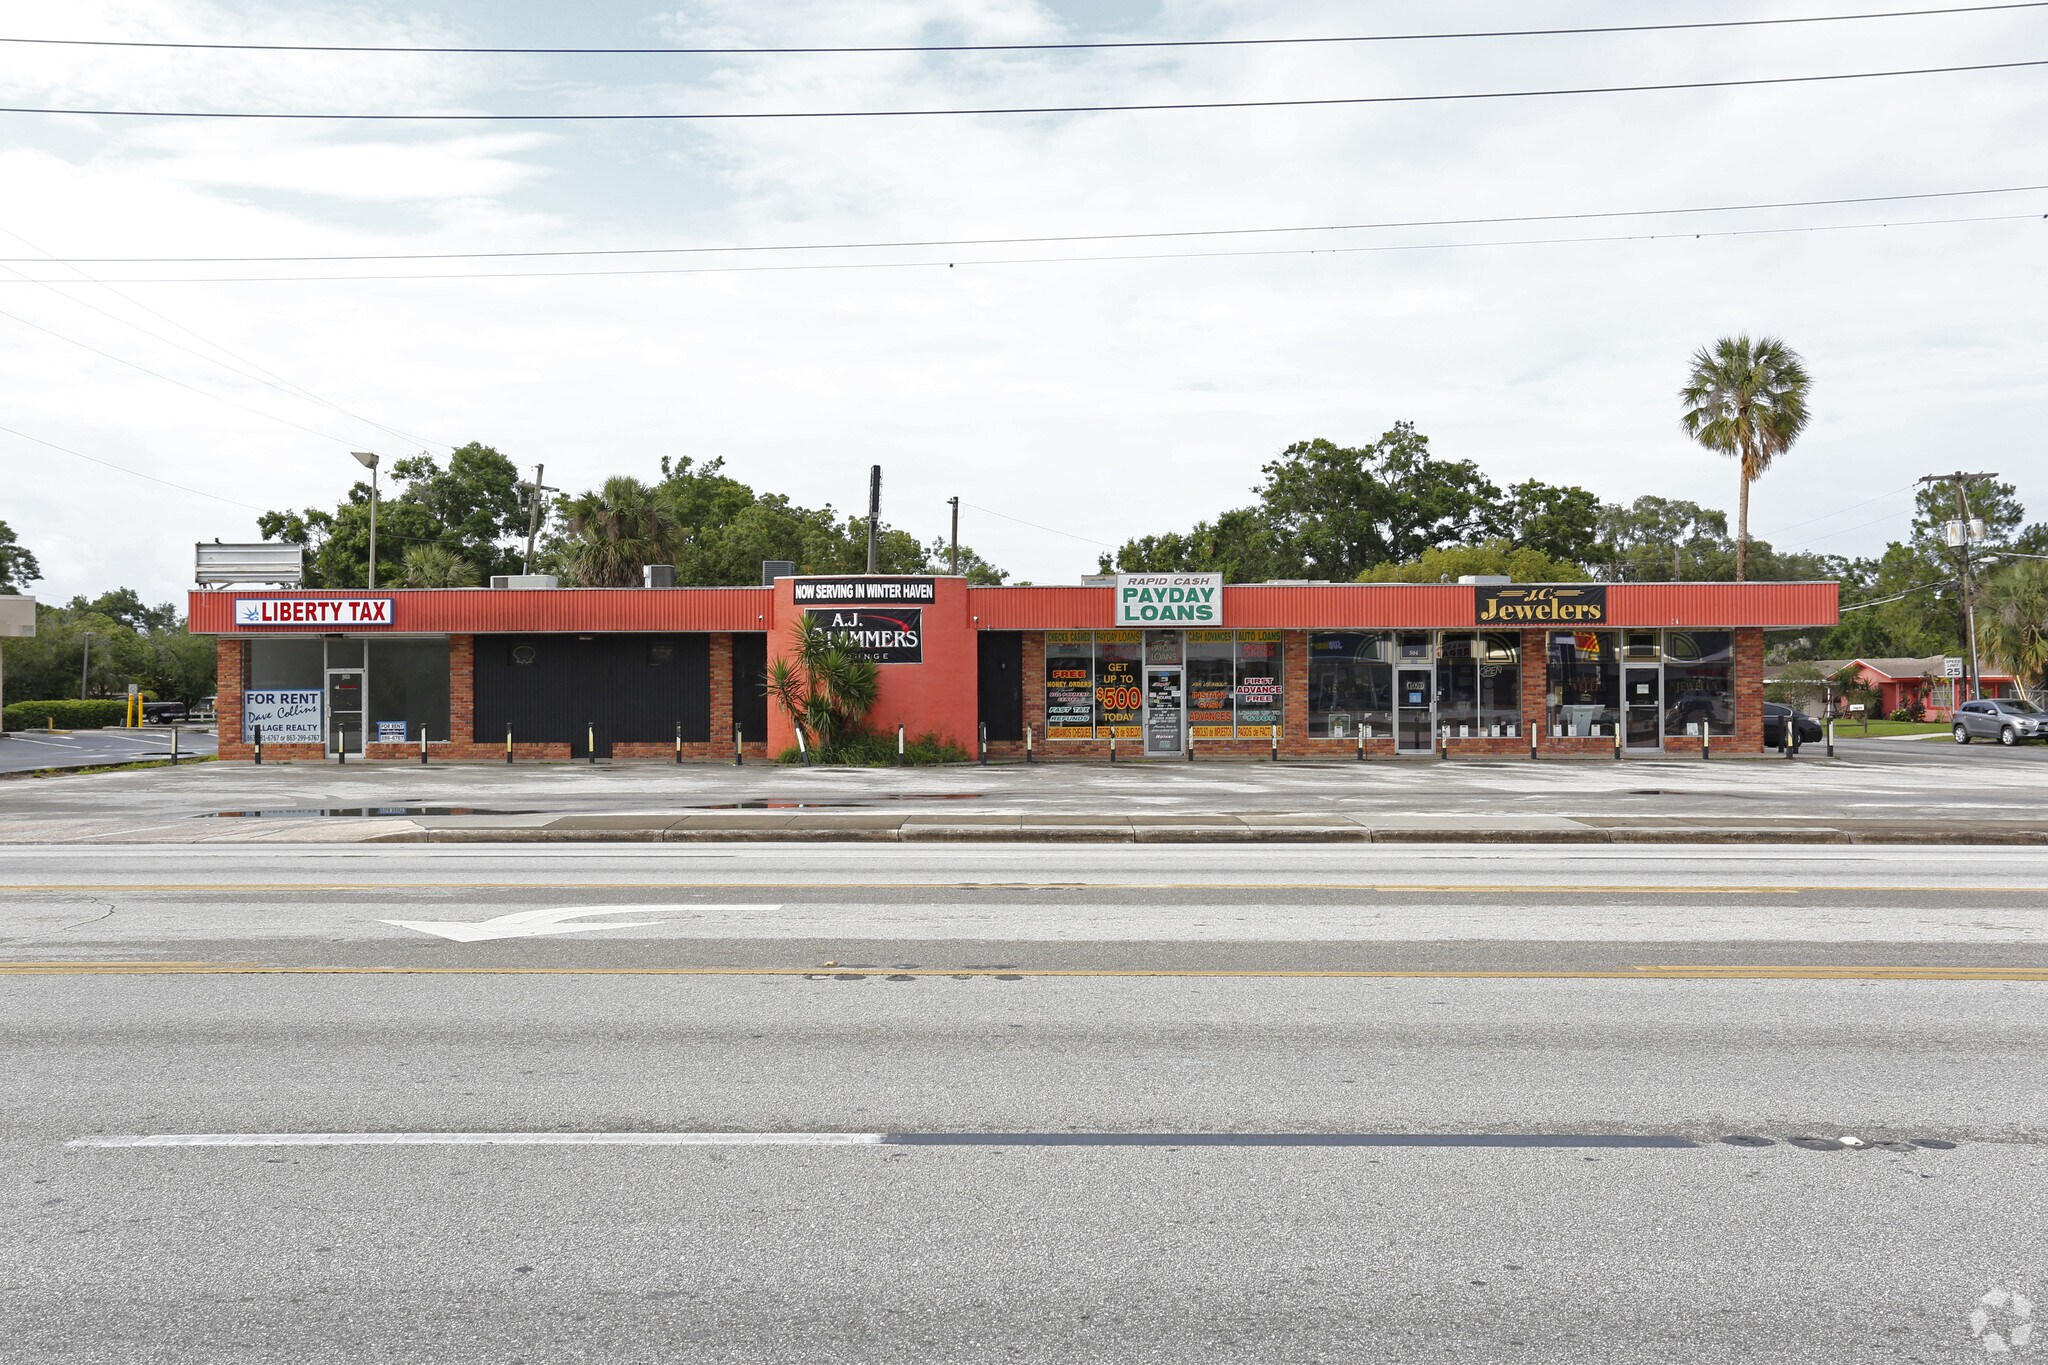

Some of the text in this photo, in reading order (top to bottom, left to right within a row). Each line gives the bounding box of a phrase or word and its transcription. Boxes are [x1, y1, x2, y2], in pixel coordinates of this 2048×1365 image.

[795, 584, 933, 599] NOW SERVING IN WINTER HAVEN
[1123, 587, 1214, 603] PAYDAY
[1524, 588, 1554, 601] J.C.
[262, 602, 386, 621] LIBERTY TAX
[1124, 605, 1213, 621] LOANS
[1480, 598, 1601, 621] Jewelers
[831, 613, 863, 627] A.J.
[811, 627, 918, 649] LMMERS
[1047, 632, 1091, 642] CHECKS CASHED
[1096, 631, 1140, 642] PAYDAY LOANS
[1188, 631, 1232, 642] CASH ADVANCES
[1238, 631, 1281, 641] AUTO LOANS
[1151, 644, 1177, 652] PAYDAY
[1151, 653, 1177, 662] LOANS
[1108, 663, 1128, 671] GET
[1480, 666, 1503, 676] OPEN
[1053, 670, 1087, 679] FREE
[1103, 675, 1134, 683] UP TO
[1245, 677, 1275, 685] FIRST
[1191, 691, 1227, 699] INSTANT
[1236, 685, 1282, 694] ADVANCE
[247, 693, 319, 704] FOR RENT
[1096, 687, 1142, 710] $500
[248, 704, 318, 724] Dave Collins
[1103, 713, 1135, 722] TODAY
[1189, 710, 1232, 722] ADVANCES
[248, 724, 318, 732] VLAGE REALTY
[1097, 727, 1119, 738] PRESTAS
[1238, 727, 1252, 737] PAGOS
[1260, 727, 1281, 737] FACTUS
